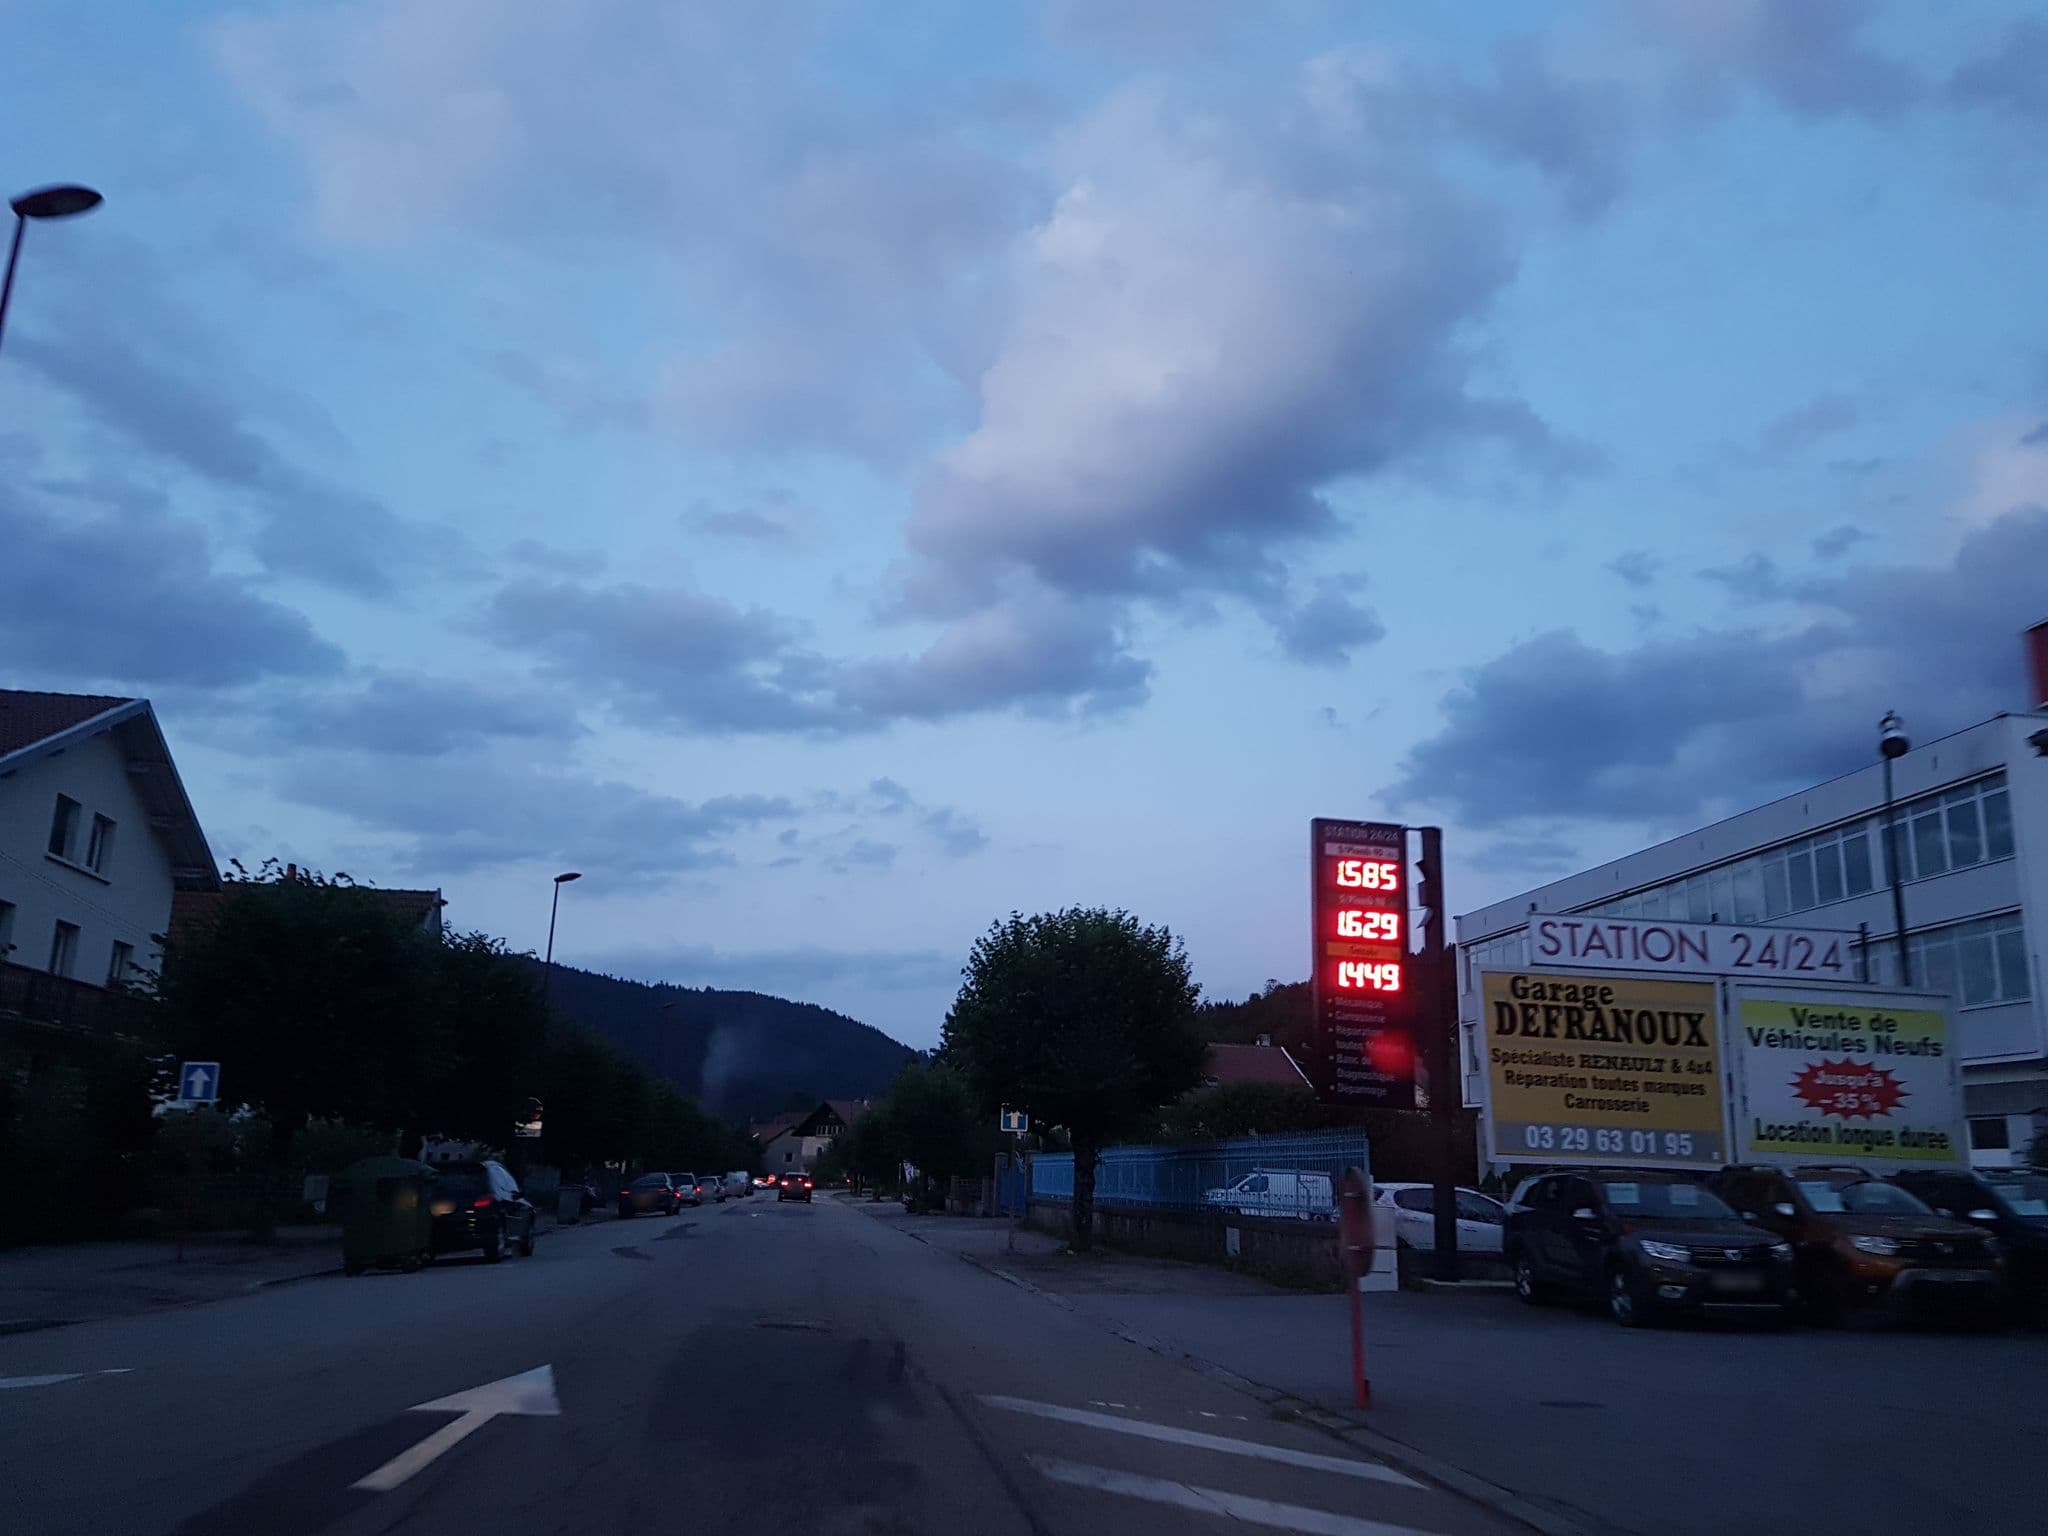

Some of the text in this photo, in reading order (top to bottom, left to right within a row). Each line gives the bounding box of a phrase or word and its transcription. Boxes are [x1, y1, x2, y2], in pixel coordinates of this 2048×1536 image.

[1538, 920, 1843, 972] STATION 24/24
[1510, 975, 1615, 1011] Garage
[1493, 1001, 1710, 1047] DEFRANOUX
[1790, 1007, 1898, 1033] Vente de
[1746, 1026, 1945, 1057] Véhicules Neufs
[1491, 1048, 1576, 1067] Spécialiste
[1579, 1054, 1665, 1073] RENAULT
[1504, 1069, 1708, 1097] Réparation toutes marques
[1563, 1093, 1650, 1113] Carrosserie
[1525, 1125, 1693, 1156] 03 29 63 01 95
[1754, 1117, 1950, 1152] Location longue durée
